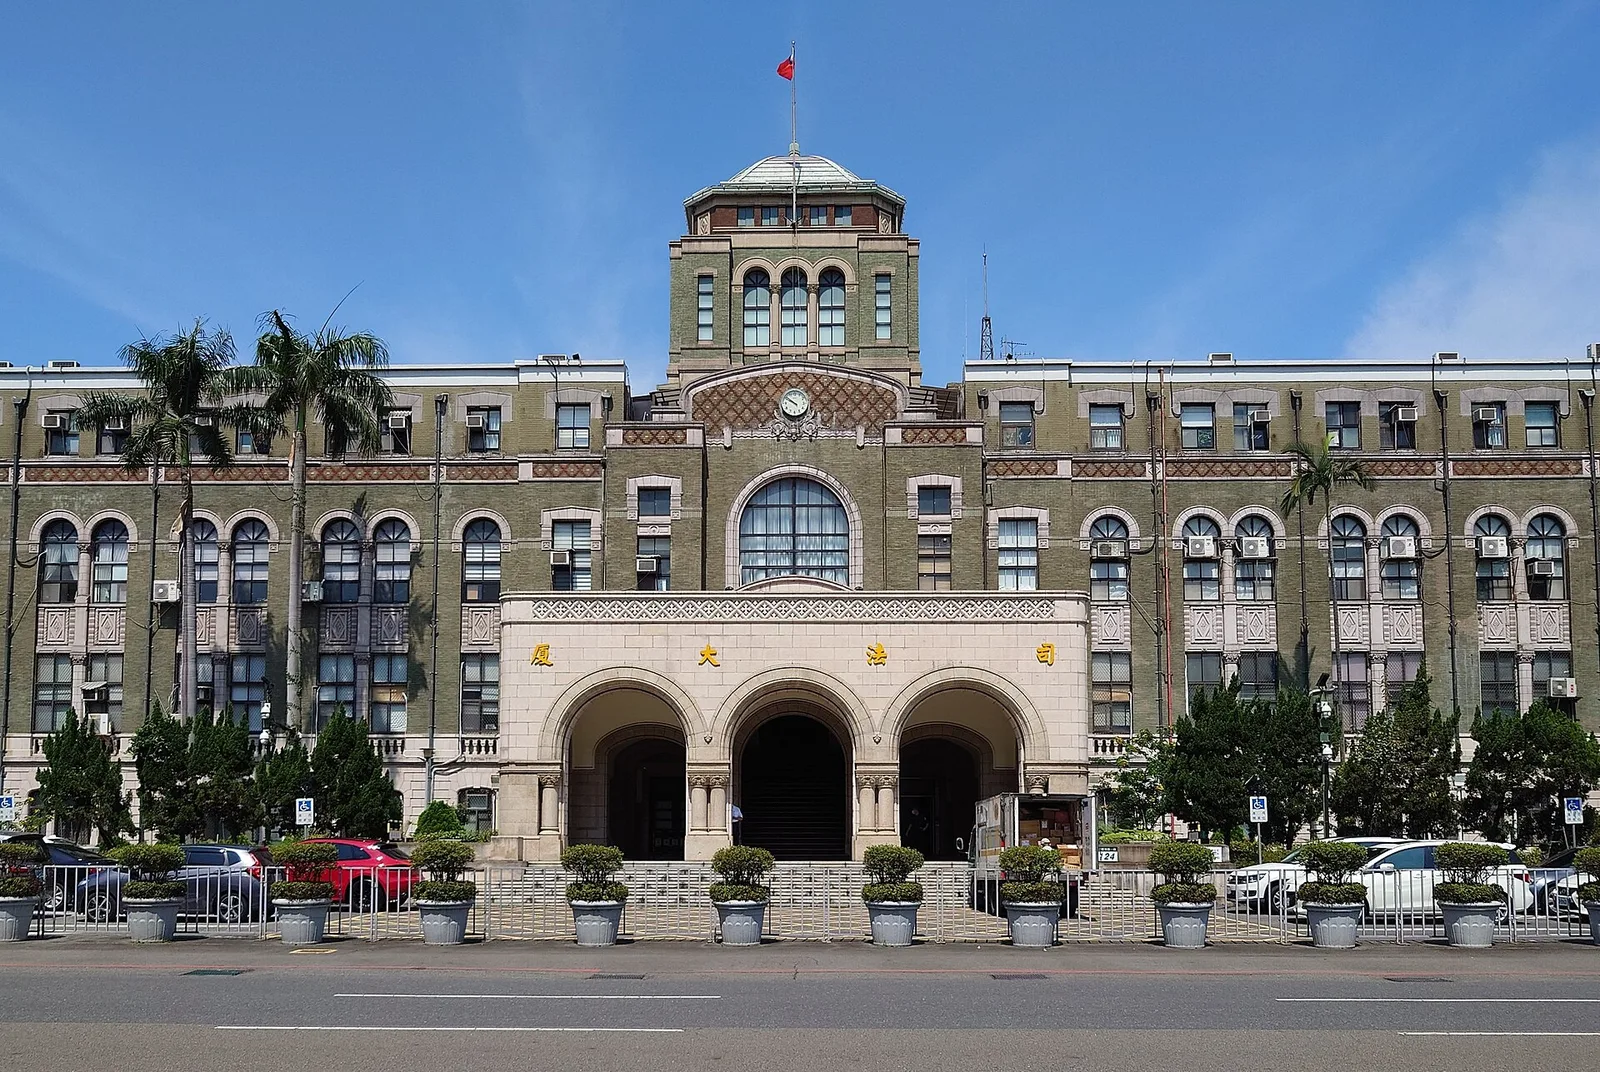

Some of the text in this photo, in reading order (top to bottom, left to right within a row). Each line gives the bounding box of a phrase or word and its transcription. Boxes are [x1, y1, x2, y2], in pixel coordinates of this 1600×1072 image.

[698, 644, 720, 667] 大
[866, 643, 887, 666] 法
[1036, 643, 1055, 666] 司
[1100, 852, 1115, 861] 124
